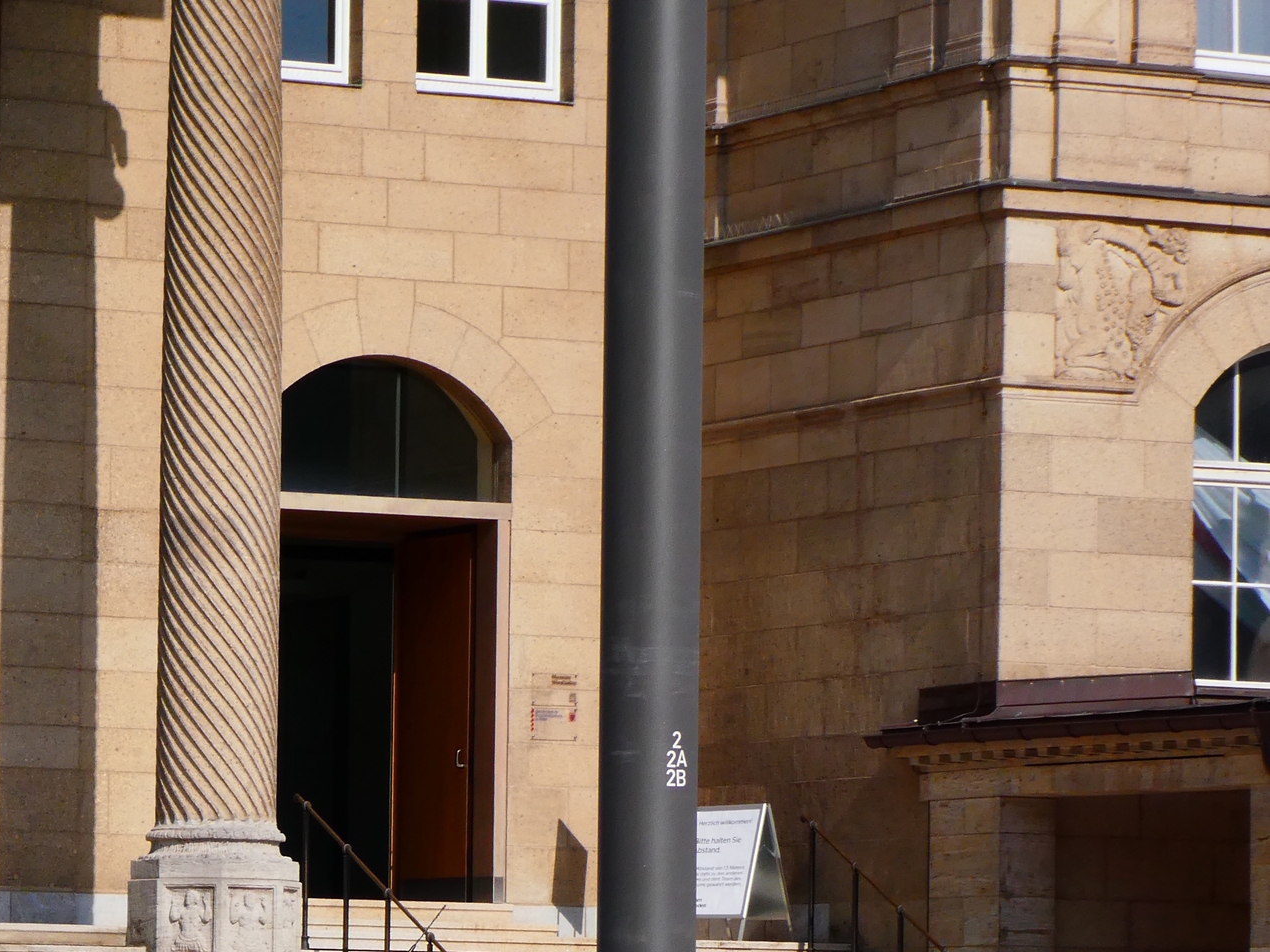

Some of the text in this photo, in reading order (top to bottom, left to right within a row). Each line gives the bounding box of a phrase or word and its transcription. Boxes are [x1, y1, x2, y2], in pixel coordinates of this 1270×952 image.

[672, 730, 682, 749] 2
[666, 749, 688, 768] 2A
[665, 769, 687, 787] 2B
[711, 836, 731, 844] halten
[732, 836, 742, 844] Sie
